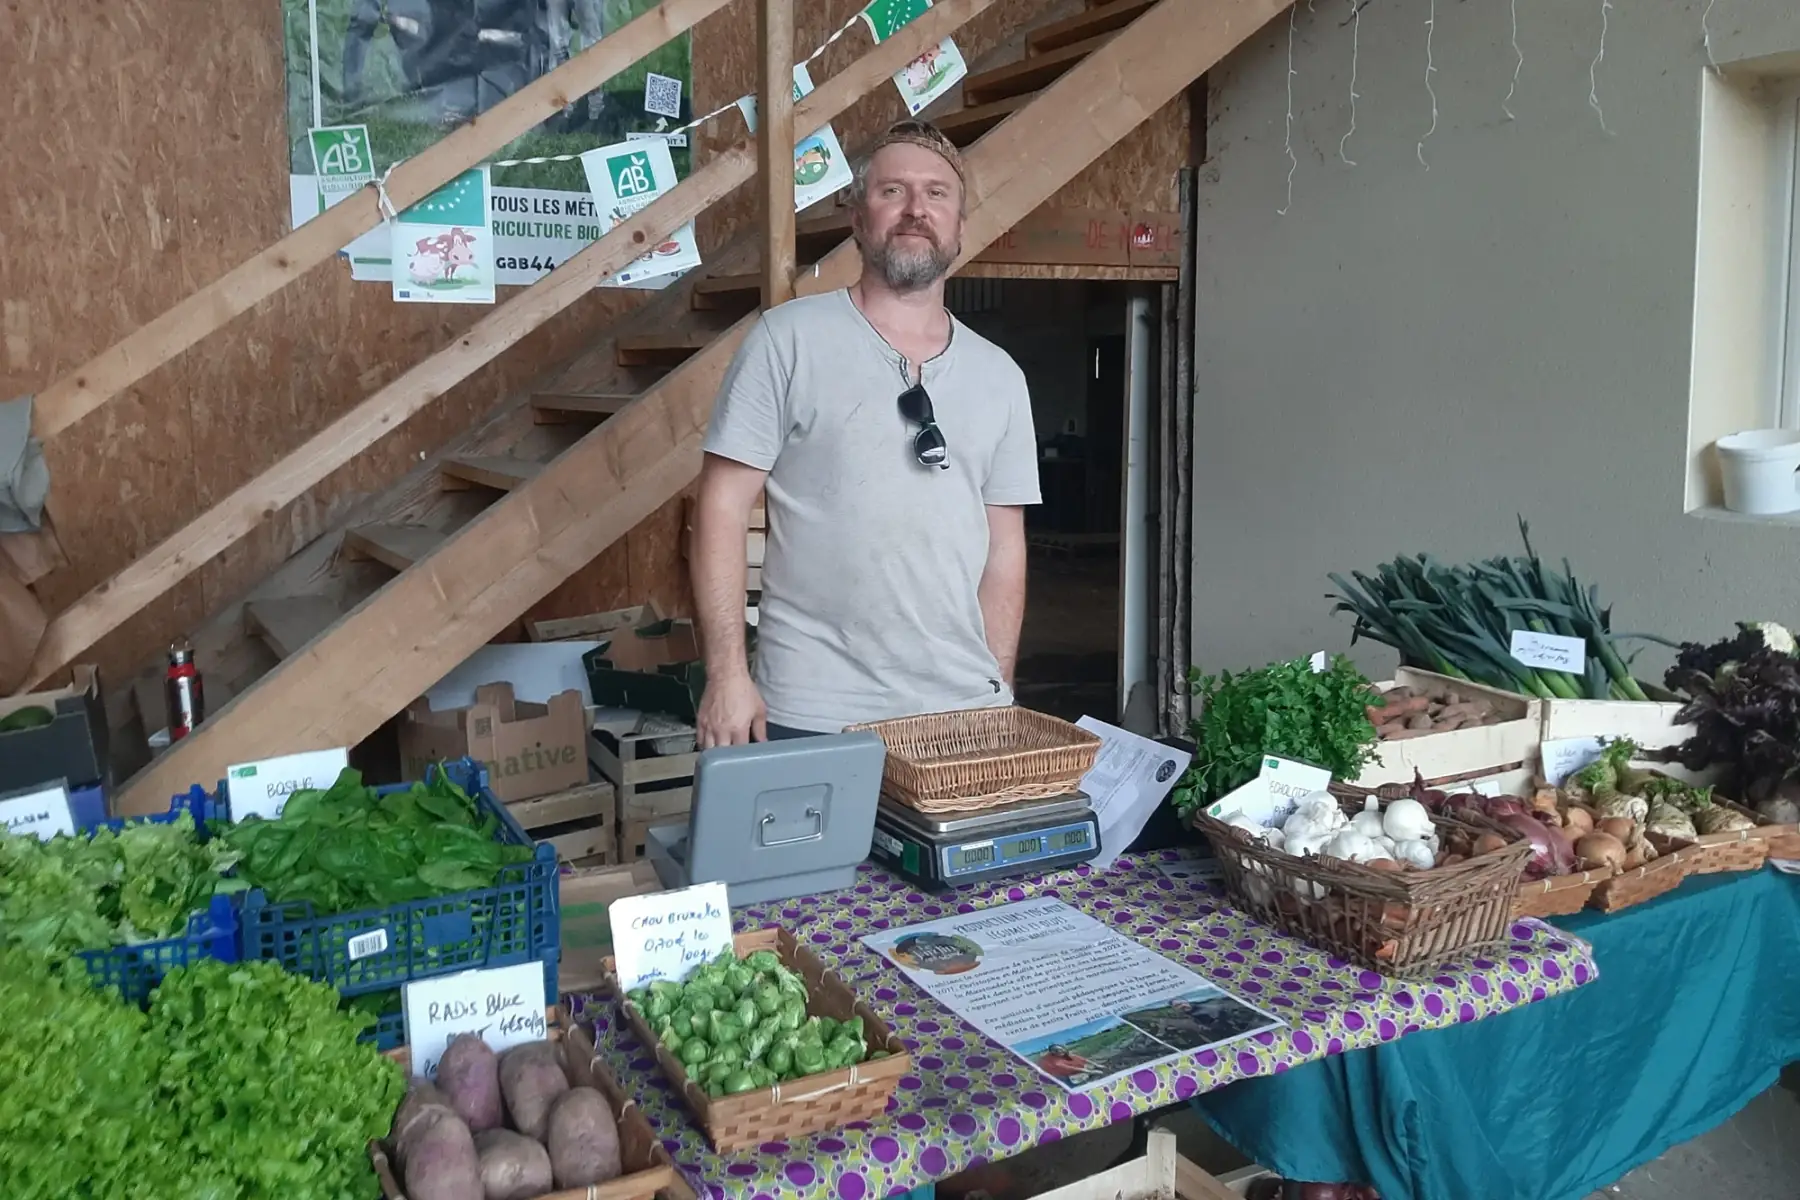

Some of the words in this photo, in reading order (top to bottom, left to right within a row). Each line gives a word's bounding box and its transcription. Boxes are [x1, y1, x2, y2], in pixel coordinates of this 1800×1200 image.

[322, 143, 362, 174] AB
[617, 165, 649, 197] AB
[491, 195, 529, 214] TOUS
[533, 198, 560, 216] LES
